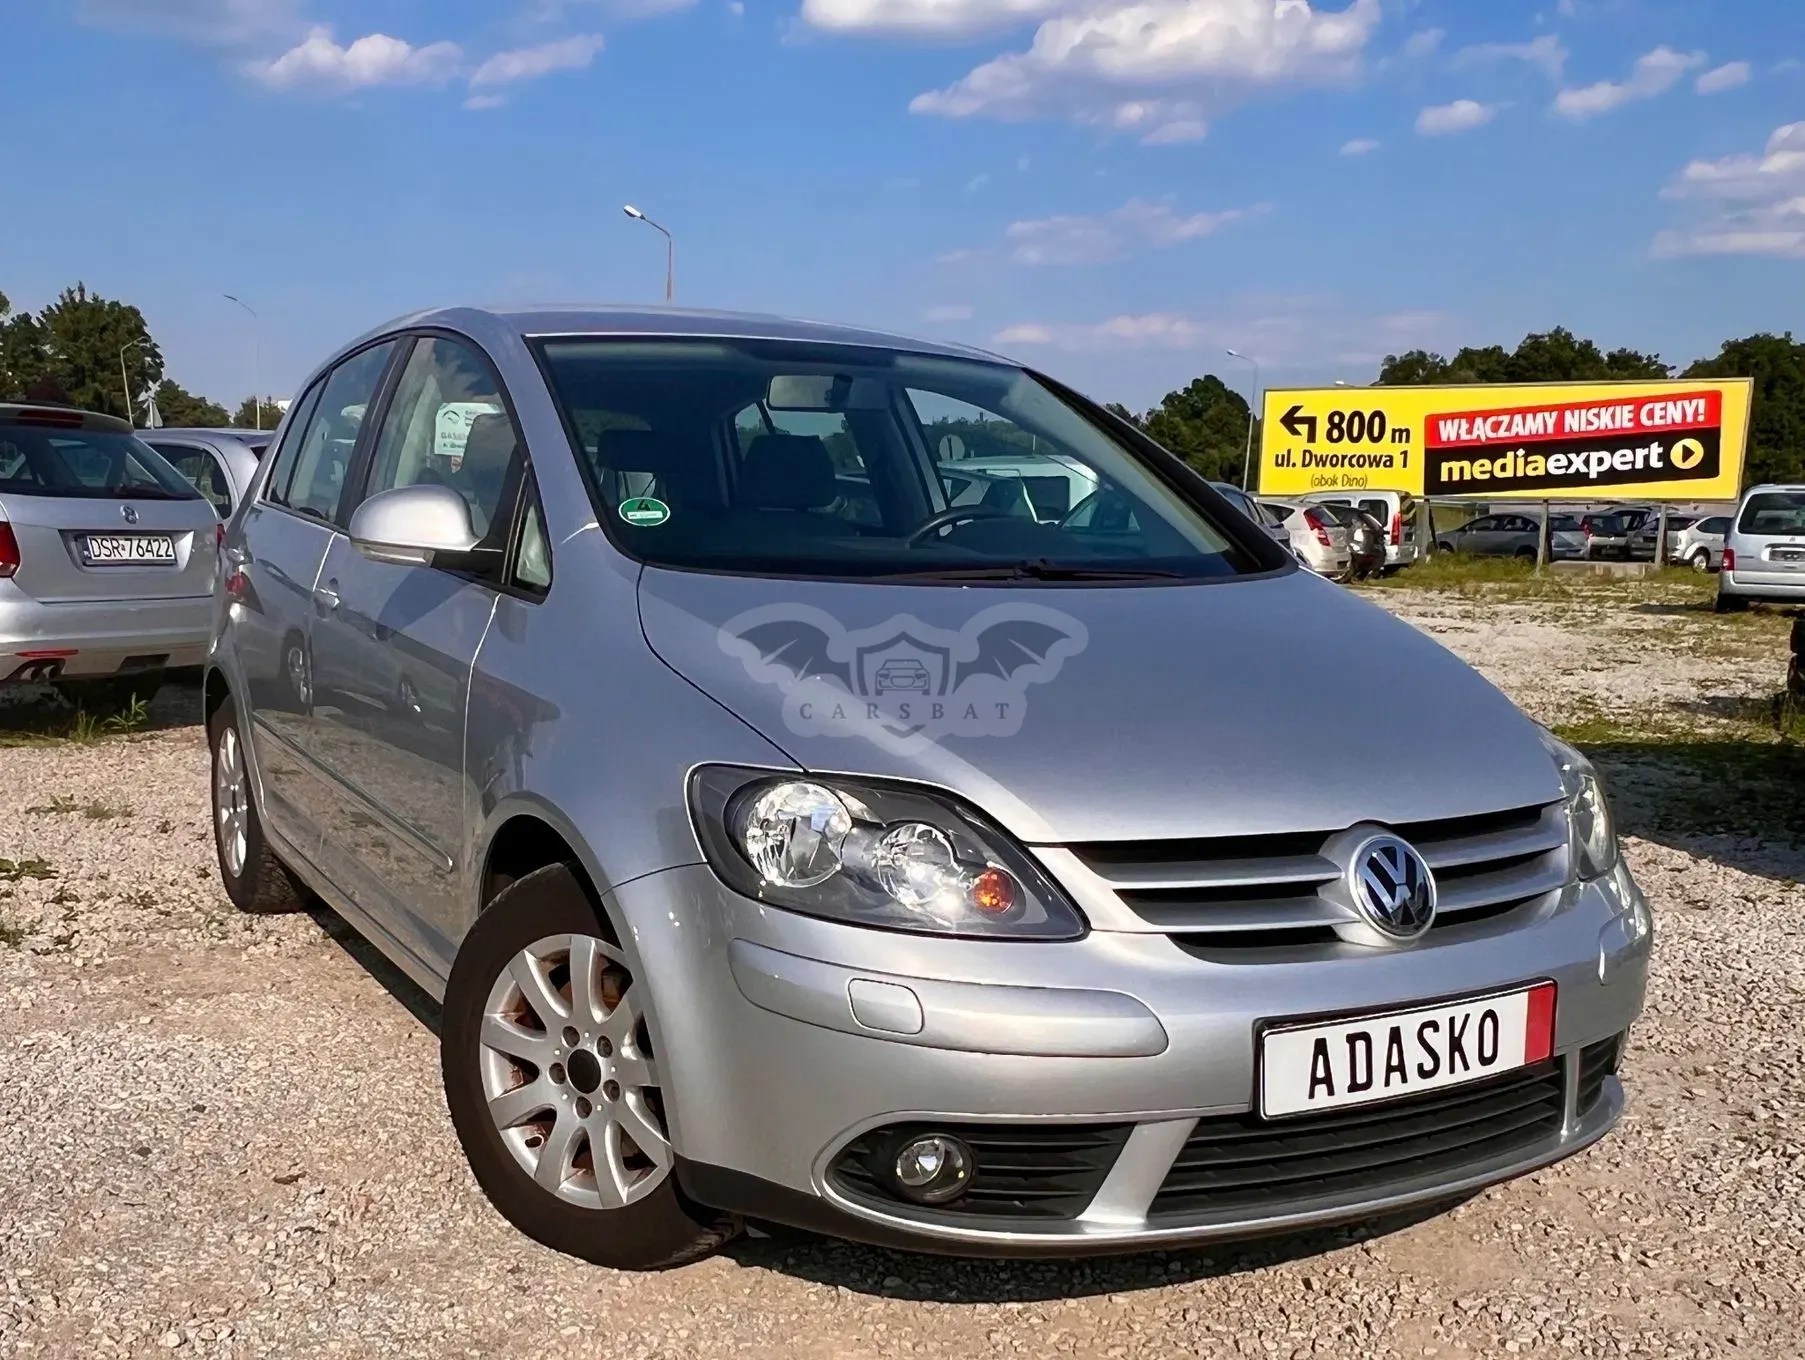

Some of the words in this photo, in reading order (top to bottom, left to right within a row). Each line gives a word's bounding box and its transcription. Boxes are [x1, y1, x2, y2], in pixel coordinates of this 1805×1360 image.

[1325, 410, 1387, 444] 800
[1390, 427, 1411, 444] m
[1438, 411, 1558, 442] WŁĄCZAMY
[1563, 404, 1635, 433] NISKIE
[1639, 398, 1706, 426] CENY!
[1274, 448, 1297, 468] ul.
[1301, 449, 1394, 469] Dworcowa
[1399, 449, 1409, 468] 1
[1440, 442, 1663, 482] mediaexpert
[1310, 473, 1339, 488] (obok
[1341, 473, 1368, 489] Dino)
[1307, 1008, 1500, 1100] ADASKO
